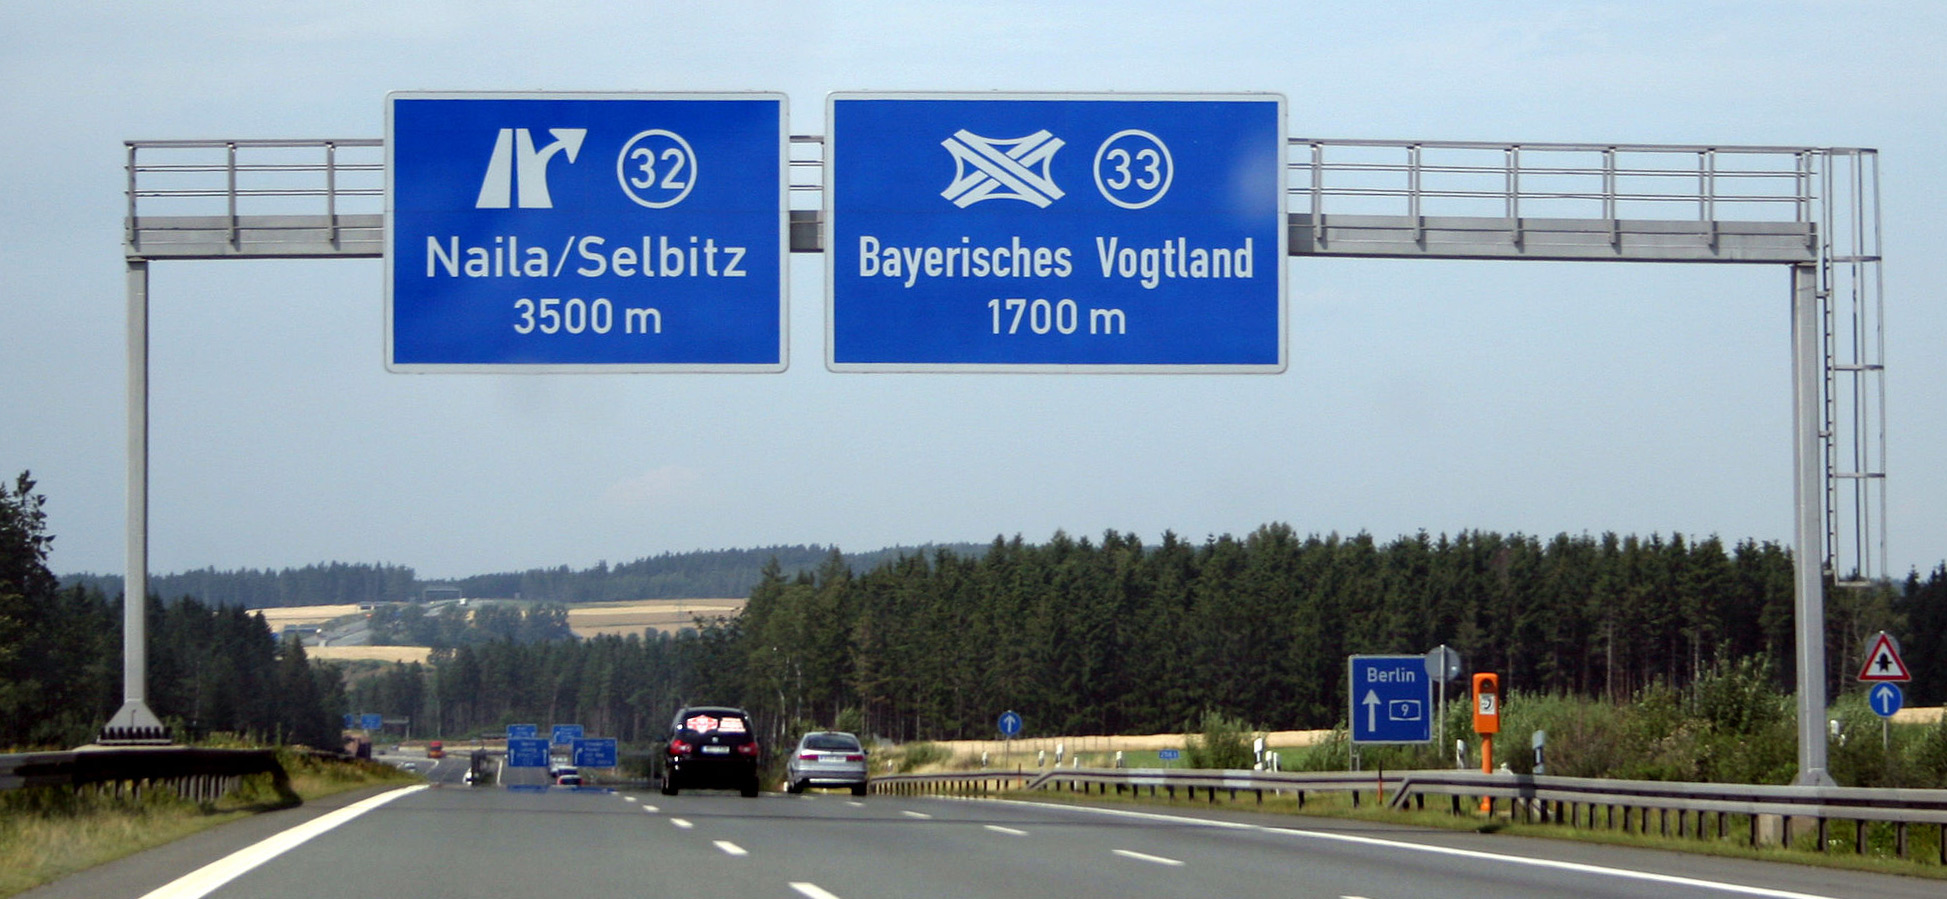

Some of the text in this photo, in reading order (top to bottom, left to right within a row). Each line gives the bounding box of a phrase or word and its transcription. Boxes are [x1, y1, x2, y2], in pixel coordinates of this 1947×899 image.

[630, 147, 686, 189] 32
[1106, 148, 1161, 191] 33
[426, 235, 747, 278] Naila/Selbitz
[859, 235, 1254, 290] Bayerisches Vogtland
[513, 298, 662, 335] 3500 m
[987, 298, 1126, 335] 1700 m
[1367, 667, 1415, 682] Berlin
[1401, 704, 1409, 716] 9
